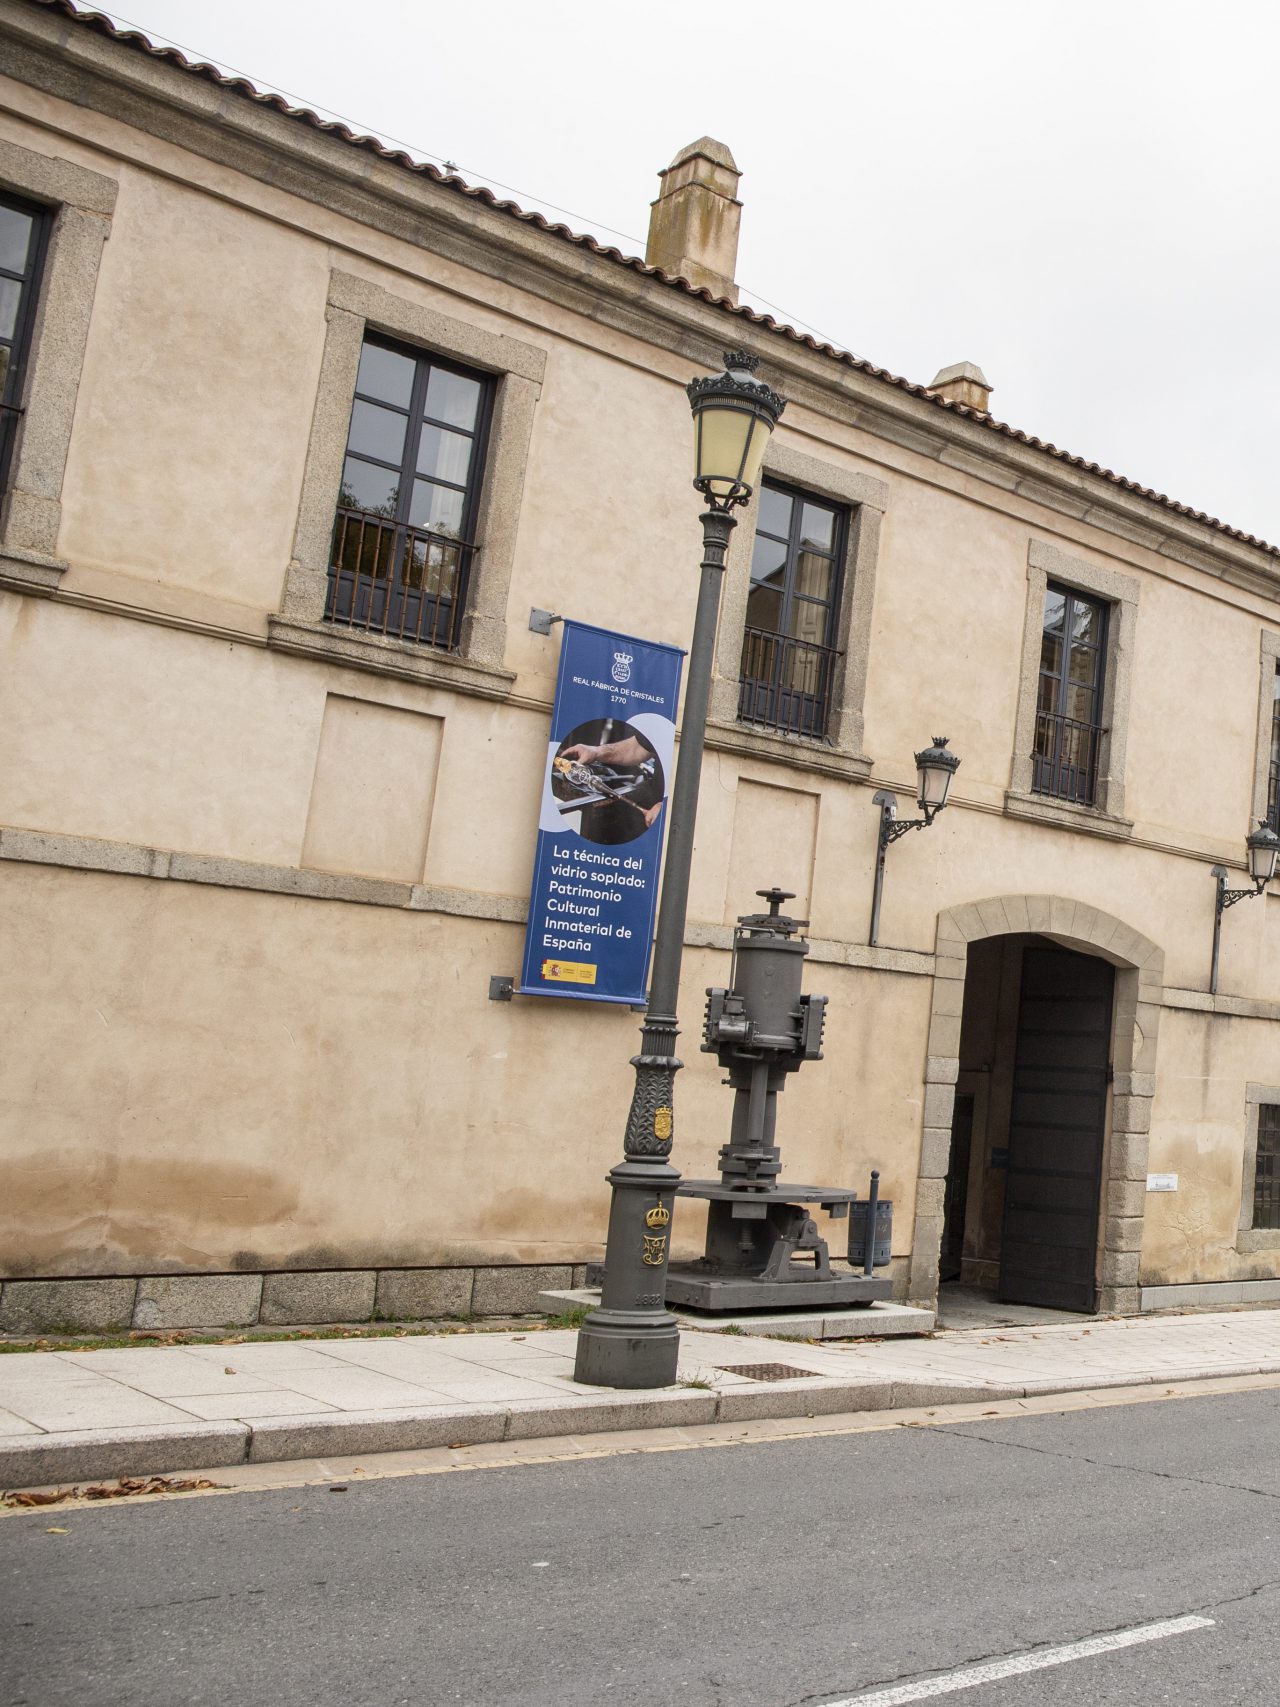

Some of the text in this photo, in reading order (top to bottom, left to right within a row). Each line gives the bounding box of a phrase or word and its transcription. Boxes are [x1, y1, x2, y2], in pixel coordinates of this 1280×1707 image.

[573, 676, 665, 704] REAL FÁBRICA DE CRISTALES
[610, 695, 627, 705] 1770
[553, 845, 643, 871] La técnica del
[551, 864, 646, 889] vidrio soplado:
[549, 880, 622, 902] Patrimonio
[547, 898, 600, 917] Cultural
[544, 916, 632, 939] Inmaterial de
[542, 934, 592, 951] España
